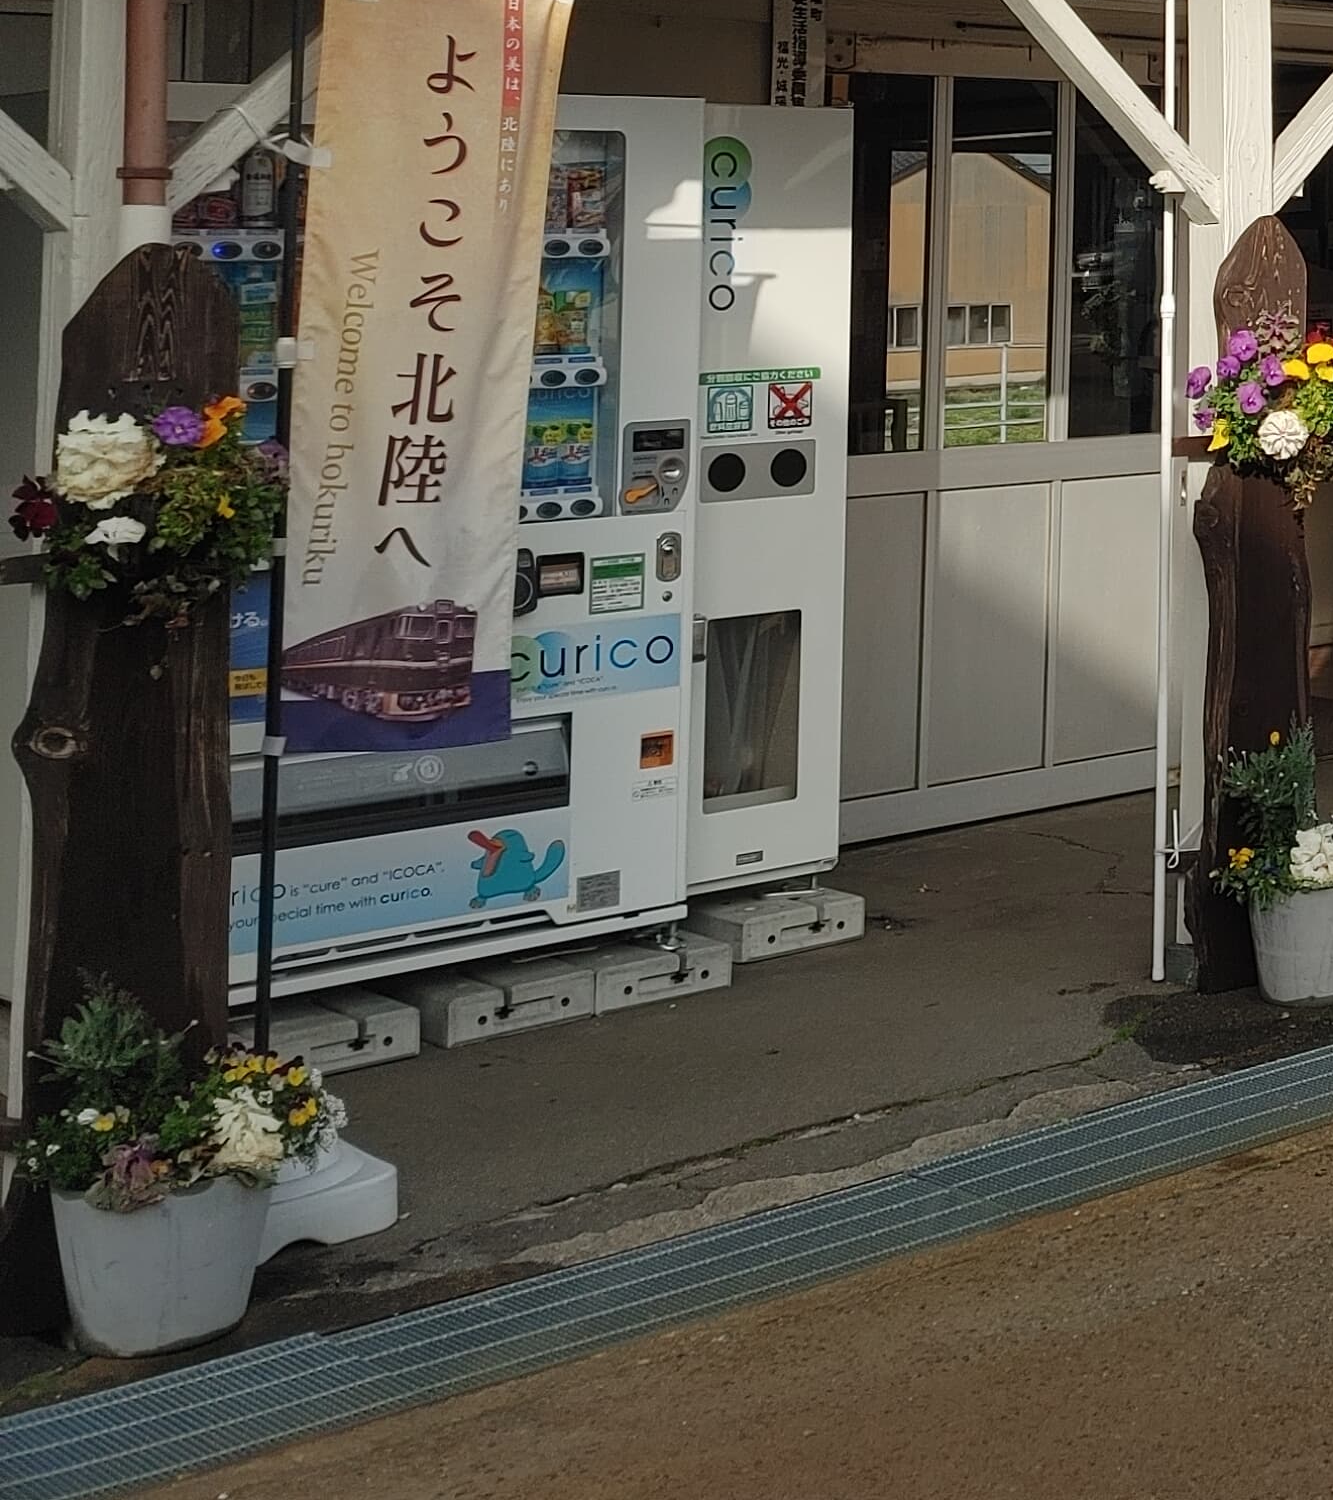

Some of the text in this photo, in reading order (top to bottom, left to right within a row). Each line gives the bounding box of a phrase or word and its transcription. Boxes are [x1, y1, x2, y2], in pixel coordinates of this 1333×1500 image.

[708, 151, 744, 311] curico
[374, 33, 477, 568] ようこそ北陸へ
[301, 249, 380, 587] Welcome to hokuriku
[511, 634, 674, 683] curico
[290, 884, 299, 897] is
[351, 873, 379, 888] and
[316, 901, 346, 915] time
[349, 895, 377, 910] with
